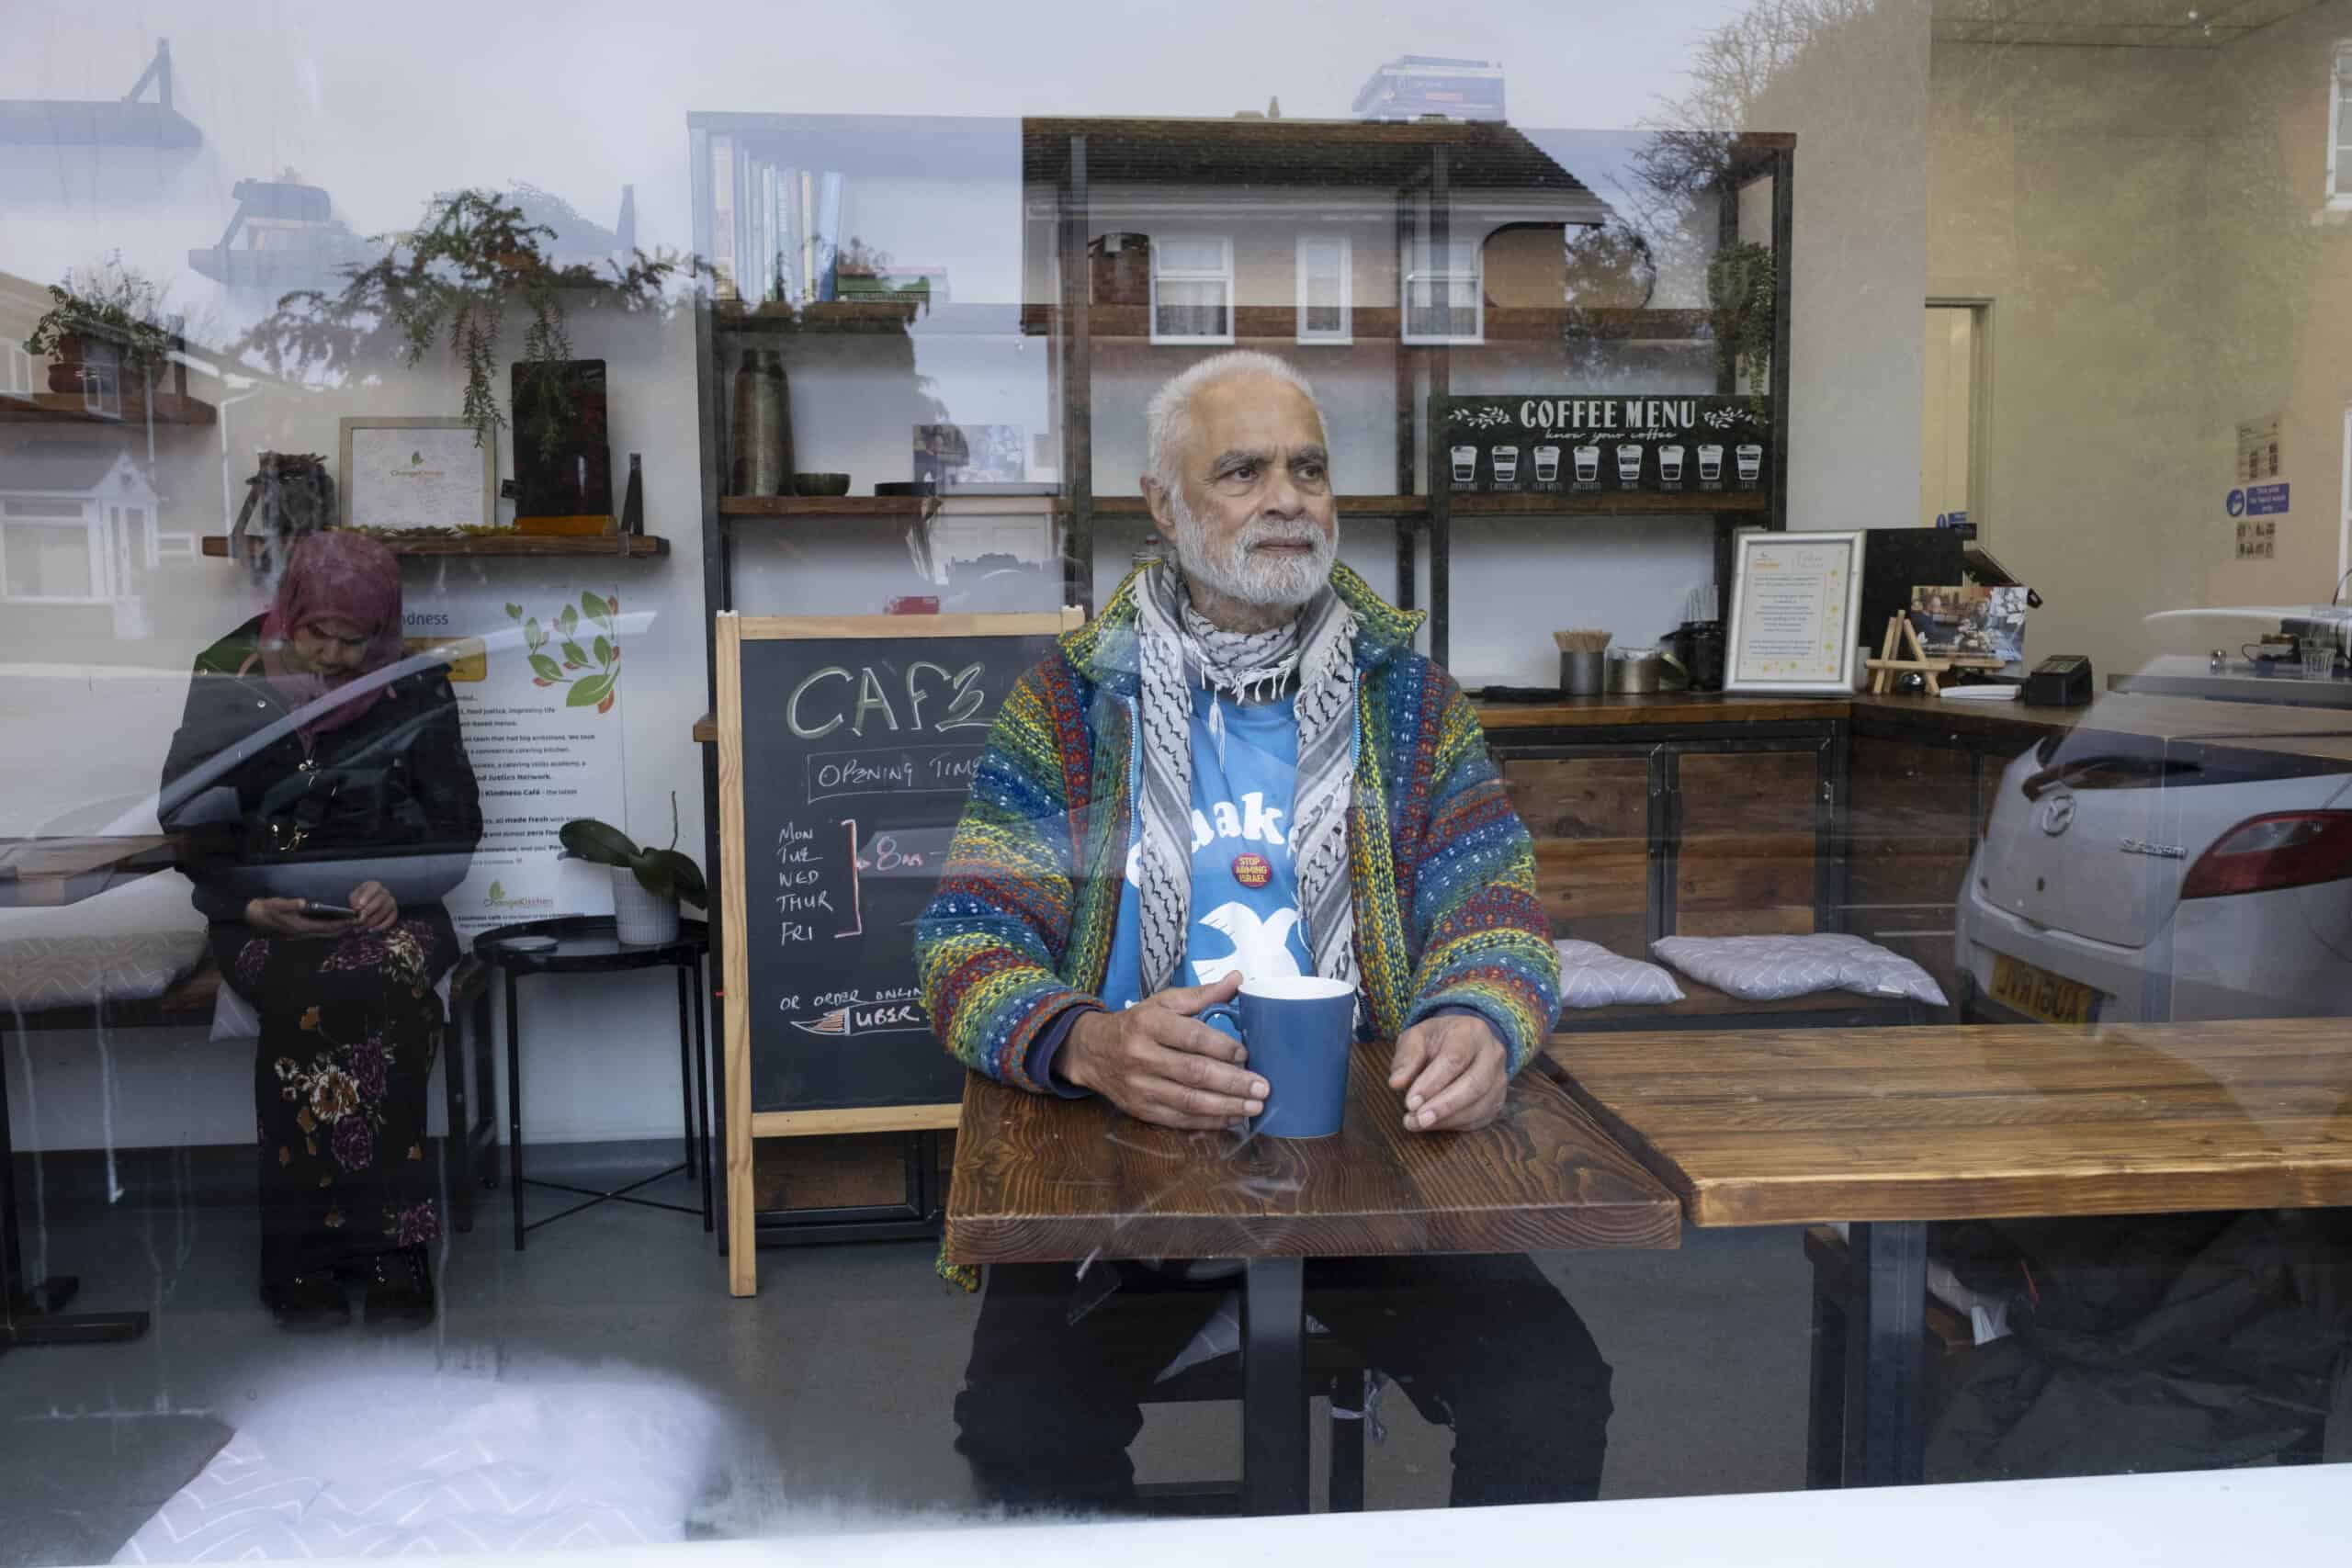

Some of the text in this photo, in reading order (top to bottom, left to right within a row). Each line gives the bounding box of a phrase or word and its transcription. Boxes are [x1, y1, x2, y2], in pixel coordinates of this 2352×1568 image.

[1520, 400, 1696, 428] COFFEE MENU
[402, 613, 449, 626] ndness
[818, 751, 984, 787] OPENING TIME
[505, 816, 527, 824] made
[1238, 856, 1261, 866] STOP
[1239, 874, 1266, 883] ISRAEL
[776, 889, 834, 912] THUR
[781, 921, 813, 946] FRI
[780, 995, 800, 1010] OR
[875, 987, 922, 1000] ONLIN
[855, 1006, 920, 1027] UBER
